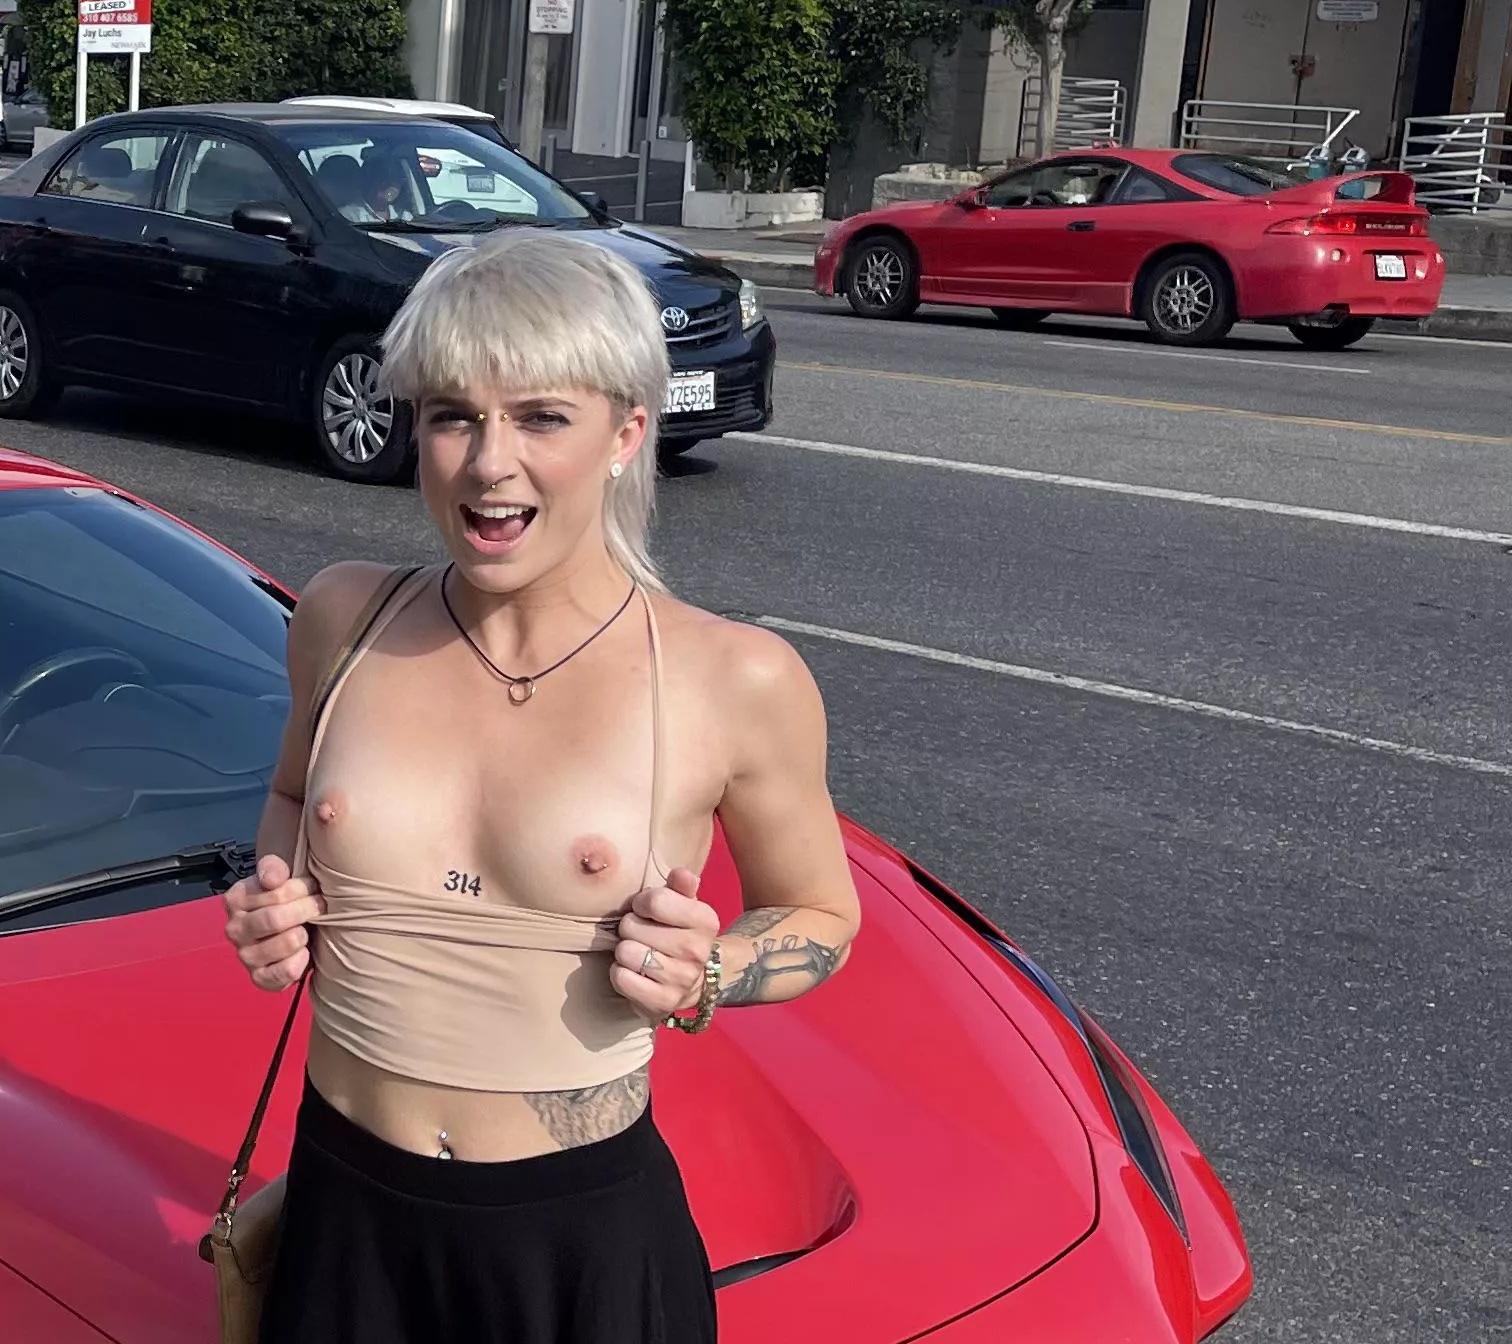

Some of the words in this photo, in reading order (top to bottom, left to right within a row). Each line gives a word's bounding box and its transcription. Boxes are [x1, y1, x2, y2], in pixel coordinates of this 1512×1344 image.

[88, 1, 127, 12] LEASED
[82, 28, 97, 39] Jay
[98, 28, 122, 38] Luchs
[669, 383, 712, 406] YZE595
[444, 869, 482, 897] 314
